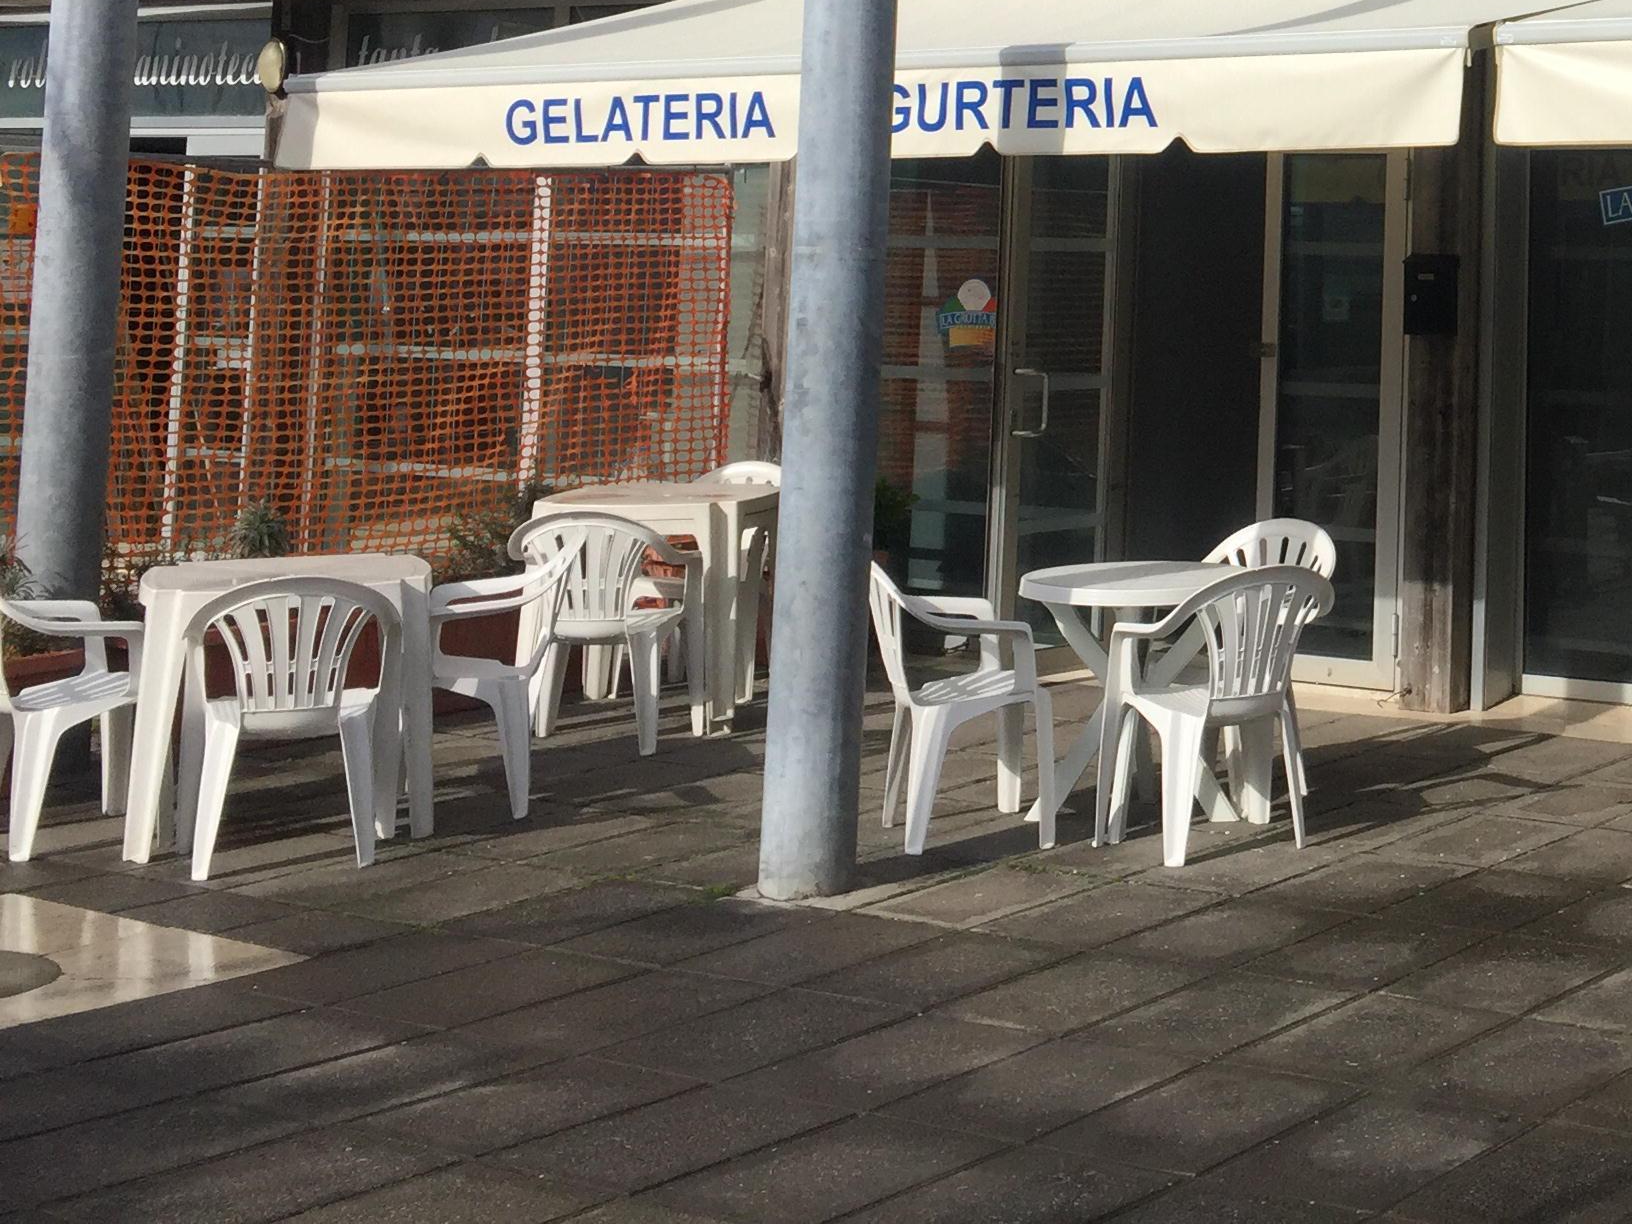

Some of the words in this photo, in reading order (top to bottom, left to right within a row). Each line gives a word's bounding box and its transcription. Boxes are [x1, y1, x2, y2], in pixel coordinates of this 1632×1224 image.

[8, 39, 48, 88] rob
[133, 37, 262, 86] aninotec
[505, 91, 777, 146] GELATERIA
[891, 77, 1159, 134] GURTERIA
